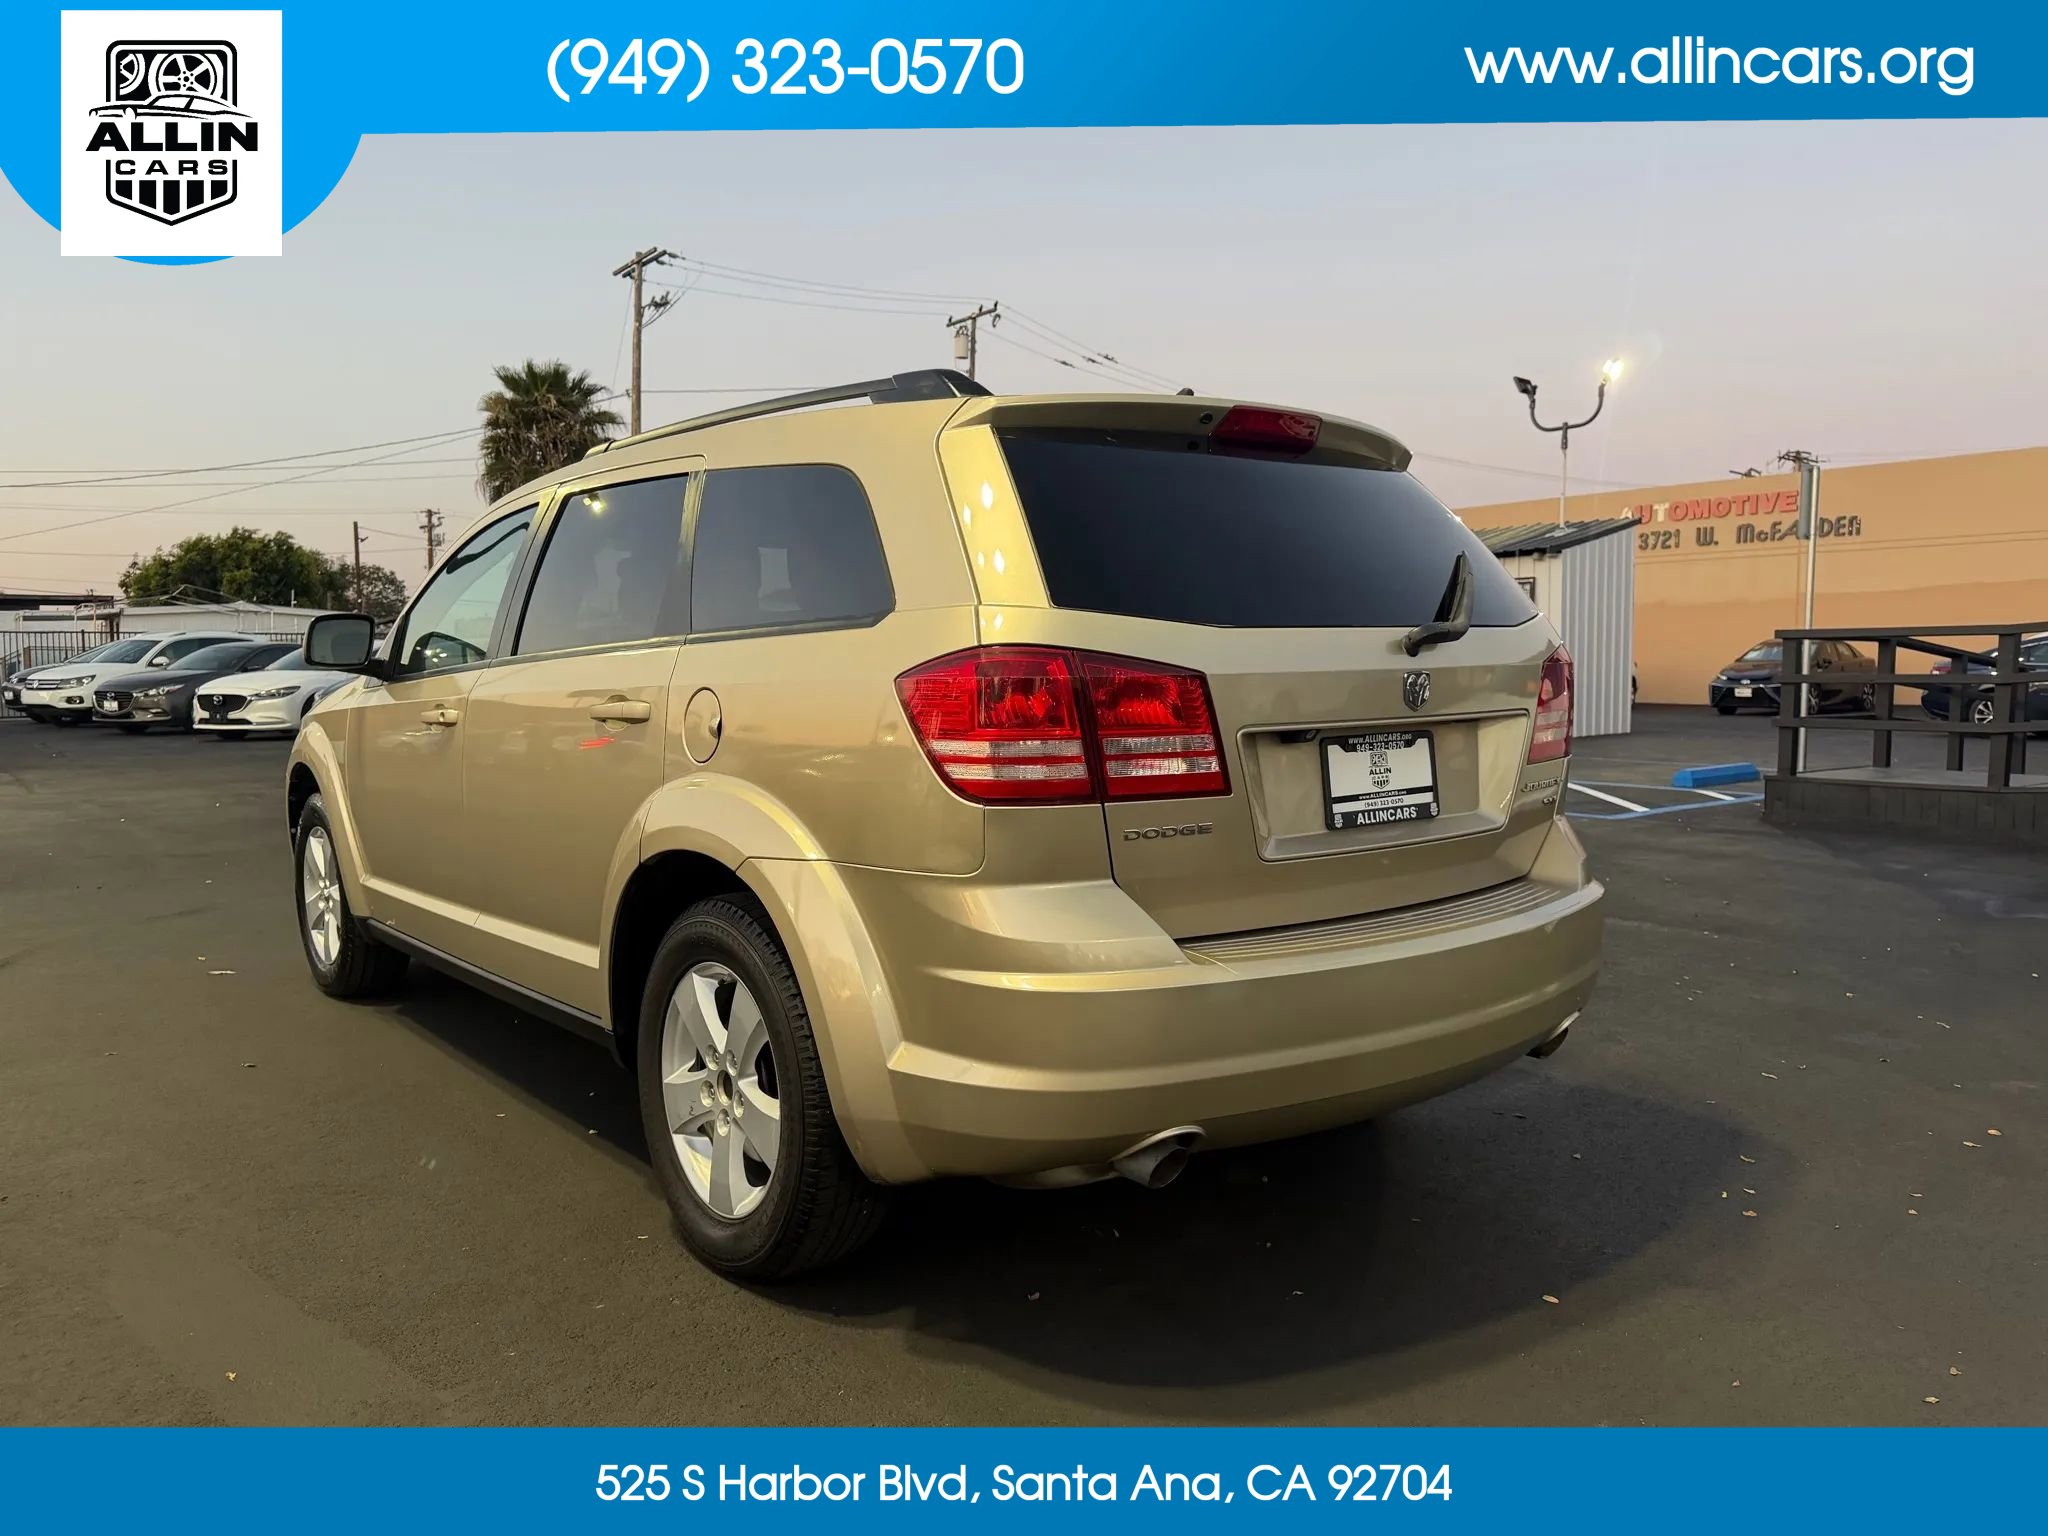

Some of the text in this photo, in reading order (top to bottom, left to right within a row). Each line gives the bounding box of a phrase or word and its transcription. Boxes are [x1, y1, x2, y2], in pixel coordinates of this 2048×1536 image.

[1638, 515, 1862, 550] 3721 W. McFADEN
[1356, 741, 1405, 752] 949-323-0570
[1369, 767, 1392, 776] ALLIN
[1357, 806, 1417, 825] ALLINCARS
[1123, 822, 1213, 841] DODGE
